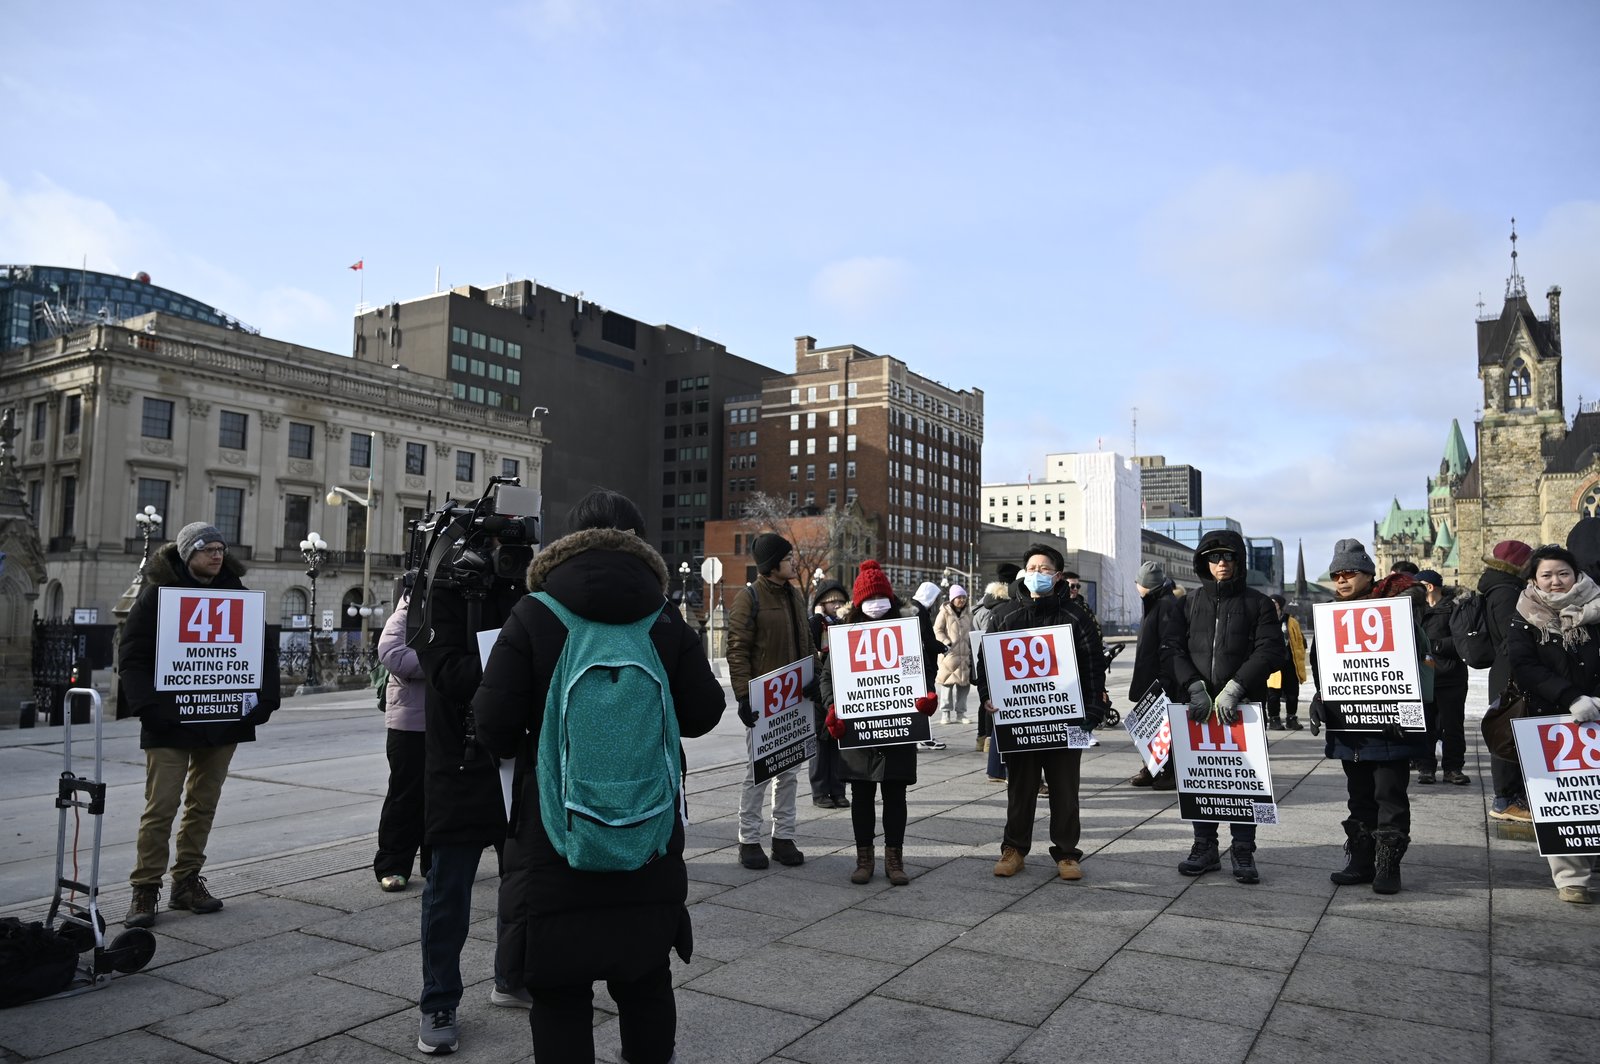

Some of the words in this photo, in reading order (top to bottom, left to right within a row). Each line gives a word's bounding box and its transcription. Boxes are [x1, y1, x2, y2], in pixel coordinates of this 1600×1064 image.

[187, 598, 235, 642] 41
[324, 619, 332, 628] 30
[1341, 607, 1384, 652] 19
[186, 647, 237, 658] MONTHS
[855, 627, 898, 670] 40
[1007, 636, 1051, 679] 39
[1343, 658, 1390, 669] MONTHS
[172, 661, 223, 672] WAITING
[227, 661, 249, 671] FOR
[164, 675, 192, 686] IRCC
[193, 674, 255, 685] RESPONSE
[857, 674, 900, 688] MONTHS
[1333, 672, 1378, 682] WAITING
[1382, 671, 1404, 681] FOR
[768, 670, 799, 714] 32
[847, 688, 890, 701] WAITING
[892, 686, 913, 696] FOR
[1012, 682, 1056, 694] MONTHS
[1328, 685, 1351, 695] IRCC
[1353, 684, 1413, 695] RESPONSE
[176, 694, 190, 704] NO
[192, 693, 243, 703] TIMELINES
[1003, 694, 1046, 707] WAITING
[1049, 693, 1069, 703] FOR
[179, 706, 194, 715] NO
[196, 704, 238, 714] RESULTS
[842, 703, 864, 714] IRCC
[866, 698, 919, 712] RESPONS
[1000, 709, 1022, 720] IRCC
[1024, 704, 1077, 718] RESPONSE
[1340, 704, 1354, 713] NO
[768, 708, 799, 729] MONTHS
[1147, 706, 1166, 726] WAITING
[1345, 715, 1359, 724] NO
[1360, 715, 1400, 724] RESULTS
[761, 722, 792, 742] WAITING
[793, 715, 806, 728] FOR
[854, 721, 866, 730] NO
[867, 717, 912, 729] TIMELINES
[1012, 726, 1024, 736] NO
[1025, 723, 1068, 734] TIMELINES
[1146, 718, 1164, 739] MONTHS
[757, 741, 774, 756] IRCC
[774, 724, 811, 749] RESPONSE
[858, 731, 870, 740] NO
[872, 728, 910, 739] RESULTS
[1016, 736, 1029, 745] NO
[1030, 733, 1066, 743] RESULTS
[1548, 722, 1600, 770] 28
[765, 755, 774, 766] NO
[775, 743, 805, 761] TIMELINES
[1197, 756, 1243, 766] MONTHS
[769, 763, 777, 774] NO
[778, 751, 803, 769] RESULTS
[1188, 768, 1232, 778] WAITING
[1235, 769, 1256, 778] FOR
[1183, 779, 1206, 789] IRCC
[1208, 780, 1265, 791] RESPONSE
[1196, 797, 1208, 805] NO
[1209, 797, 1255, 806] TIMELINES
[1545, 789, 1600, 802] WAITING
[1200, 807, 1212, 815] NO
[1215, 807, 1252, 816] RESULTS
[1540, 805, 1570, 817] IRCC
[1572, 804, 1600, 816] RES
[1558, 826, 1574, 836] NO
[1565, 838, 1582, 847] NO
[1584, 837, 1600, 847] RE
